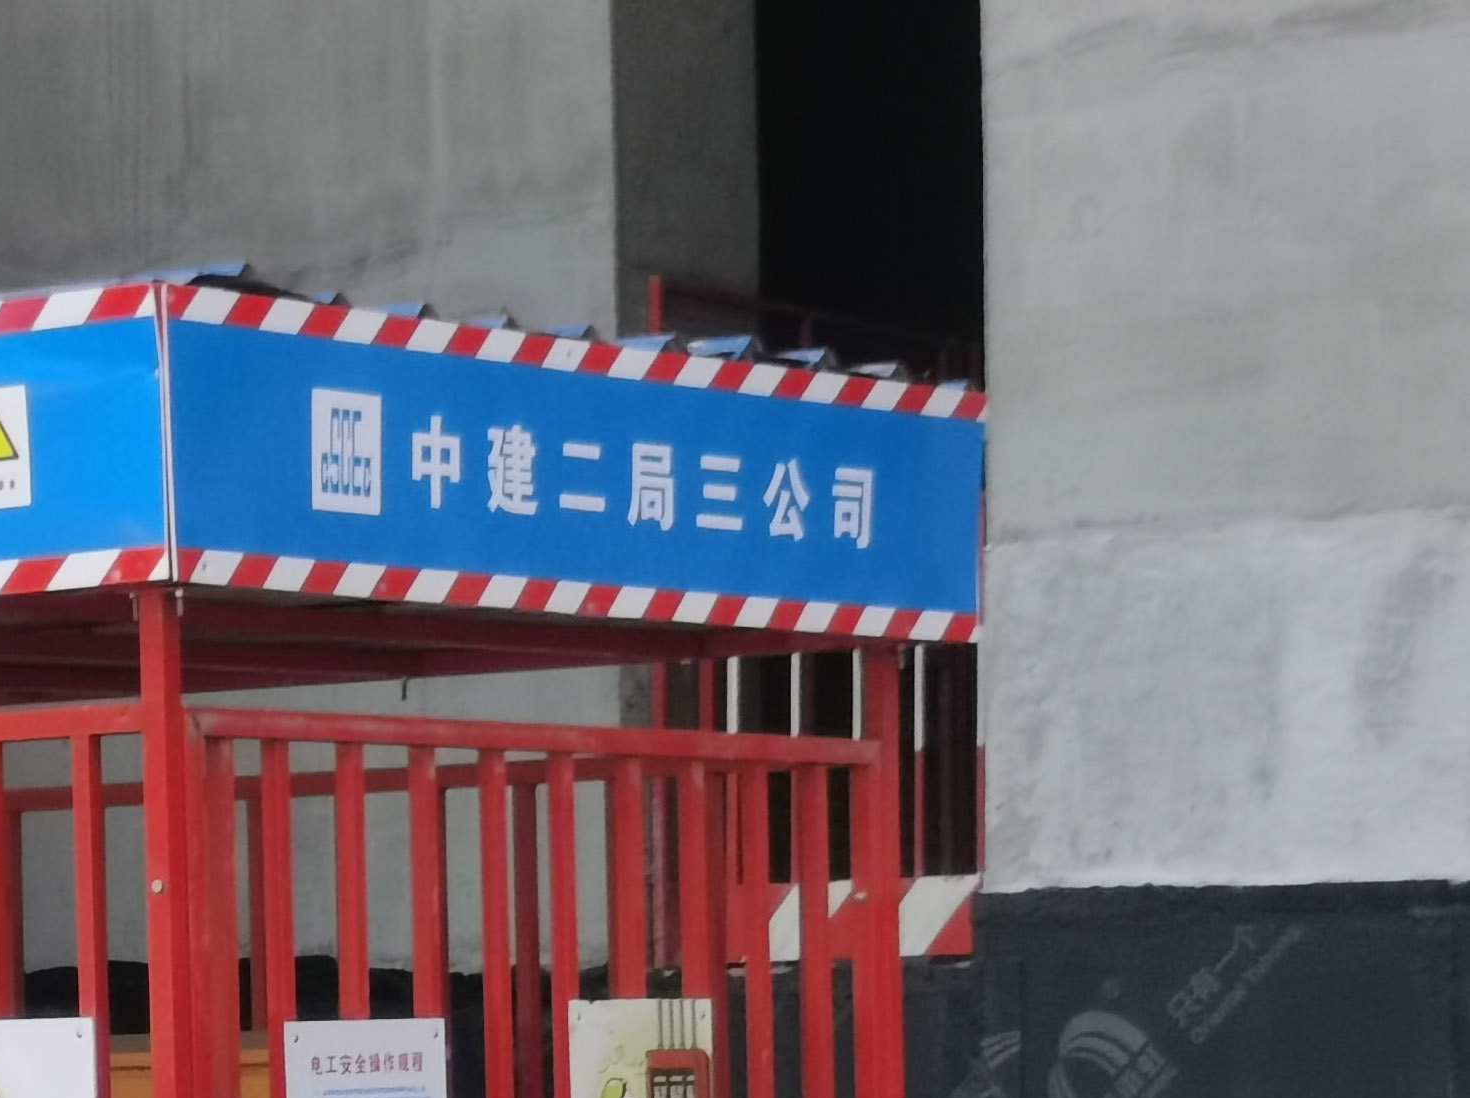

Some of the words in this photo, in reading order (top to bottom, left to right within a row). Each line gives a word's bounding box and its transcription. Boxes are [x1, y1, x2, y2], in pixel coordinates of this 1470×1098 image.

[411, 414, 874, 550] 中建二局三公司
